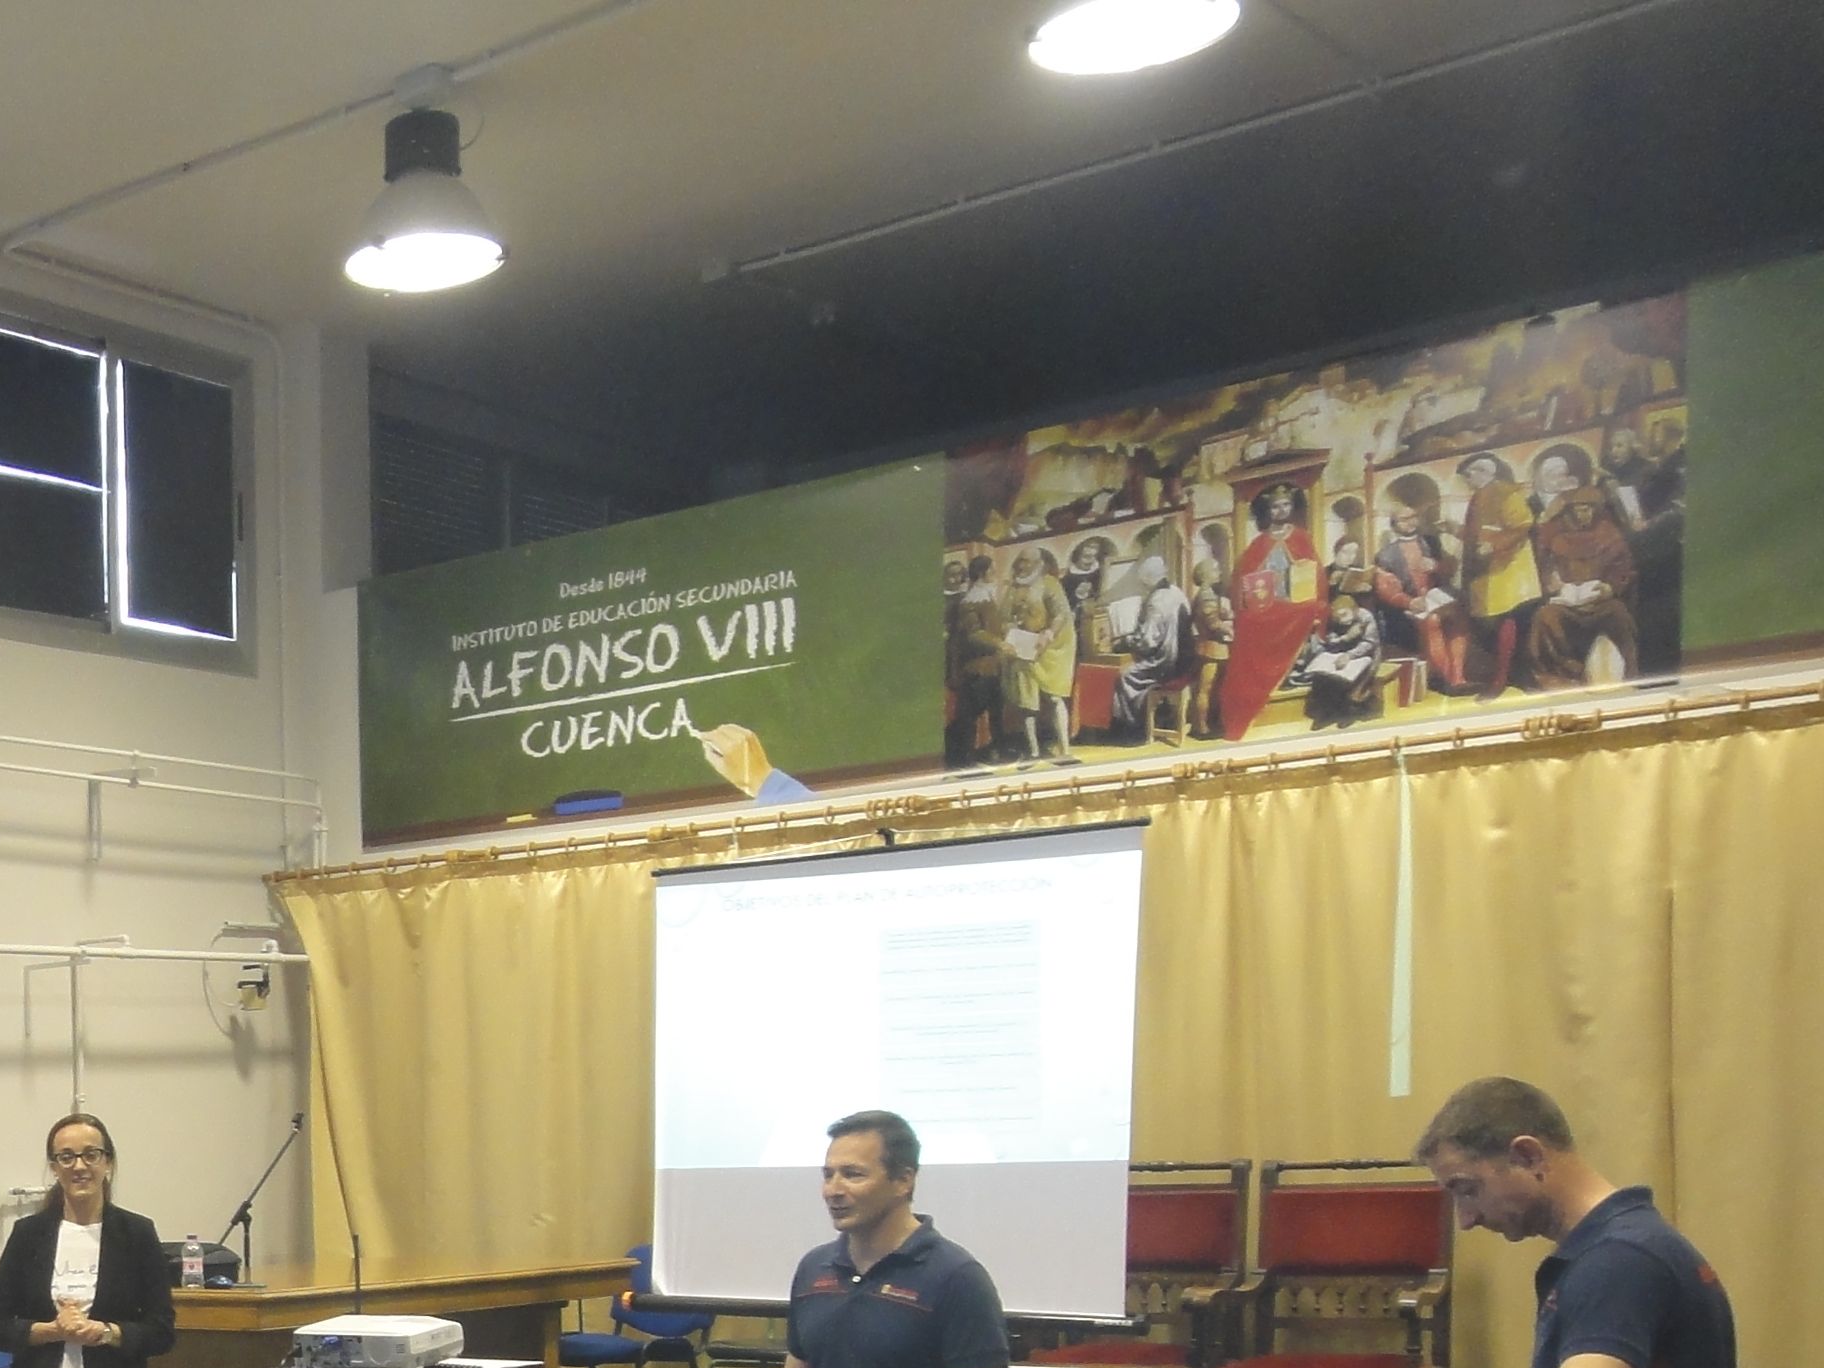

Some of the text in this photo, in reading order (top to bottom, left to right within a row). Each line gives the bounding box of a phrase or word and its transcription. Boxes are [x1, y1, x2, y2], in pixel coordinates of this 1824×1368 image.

[451, 570, 798, 652] INSTITUTO DE EDUCACIÓN SECUNDARIA
[559, 567, 647, 599] Desde 1844
[451, 596, 797, 709] ALFONSO VIII
[520, 697, 700, 759] CUENCA
